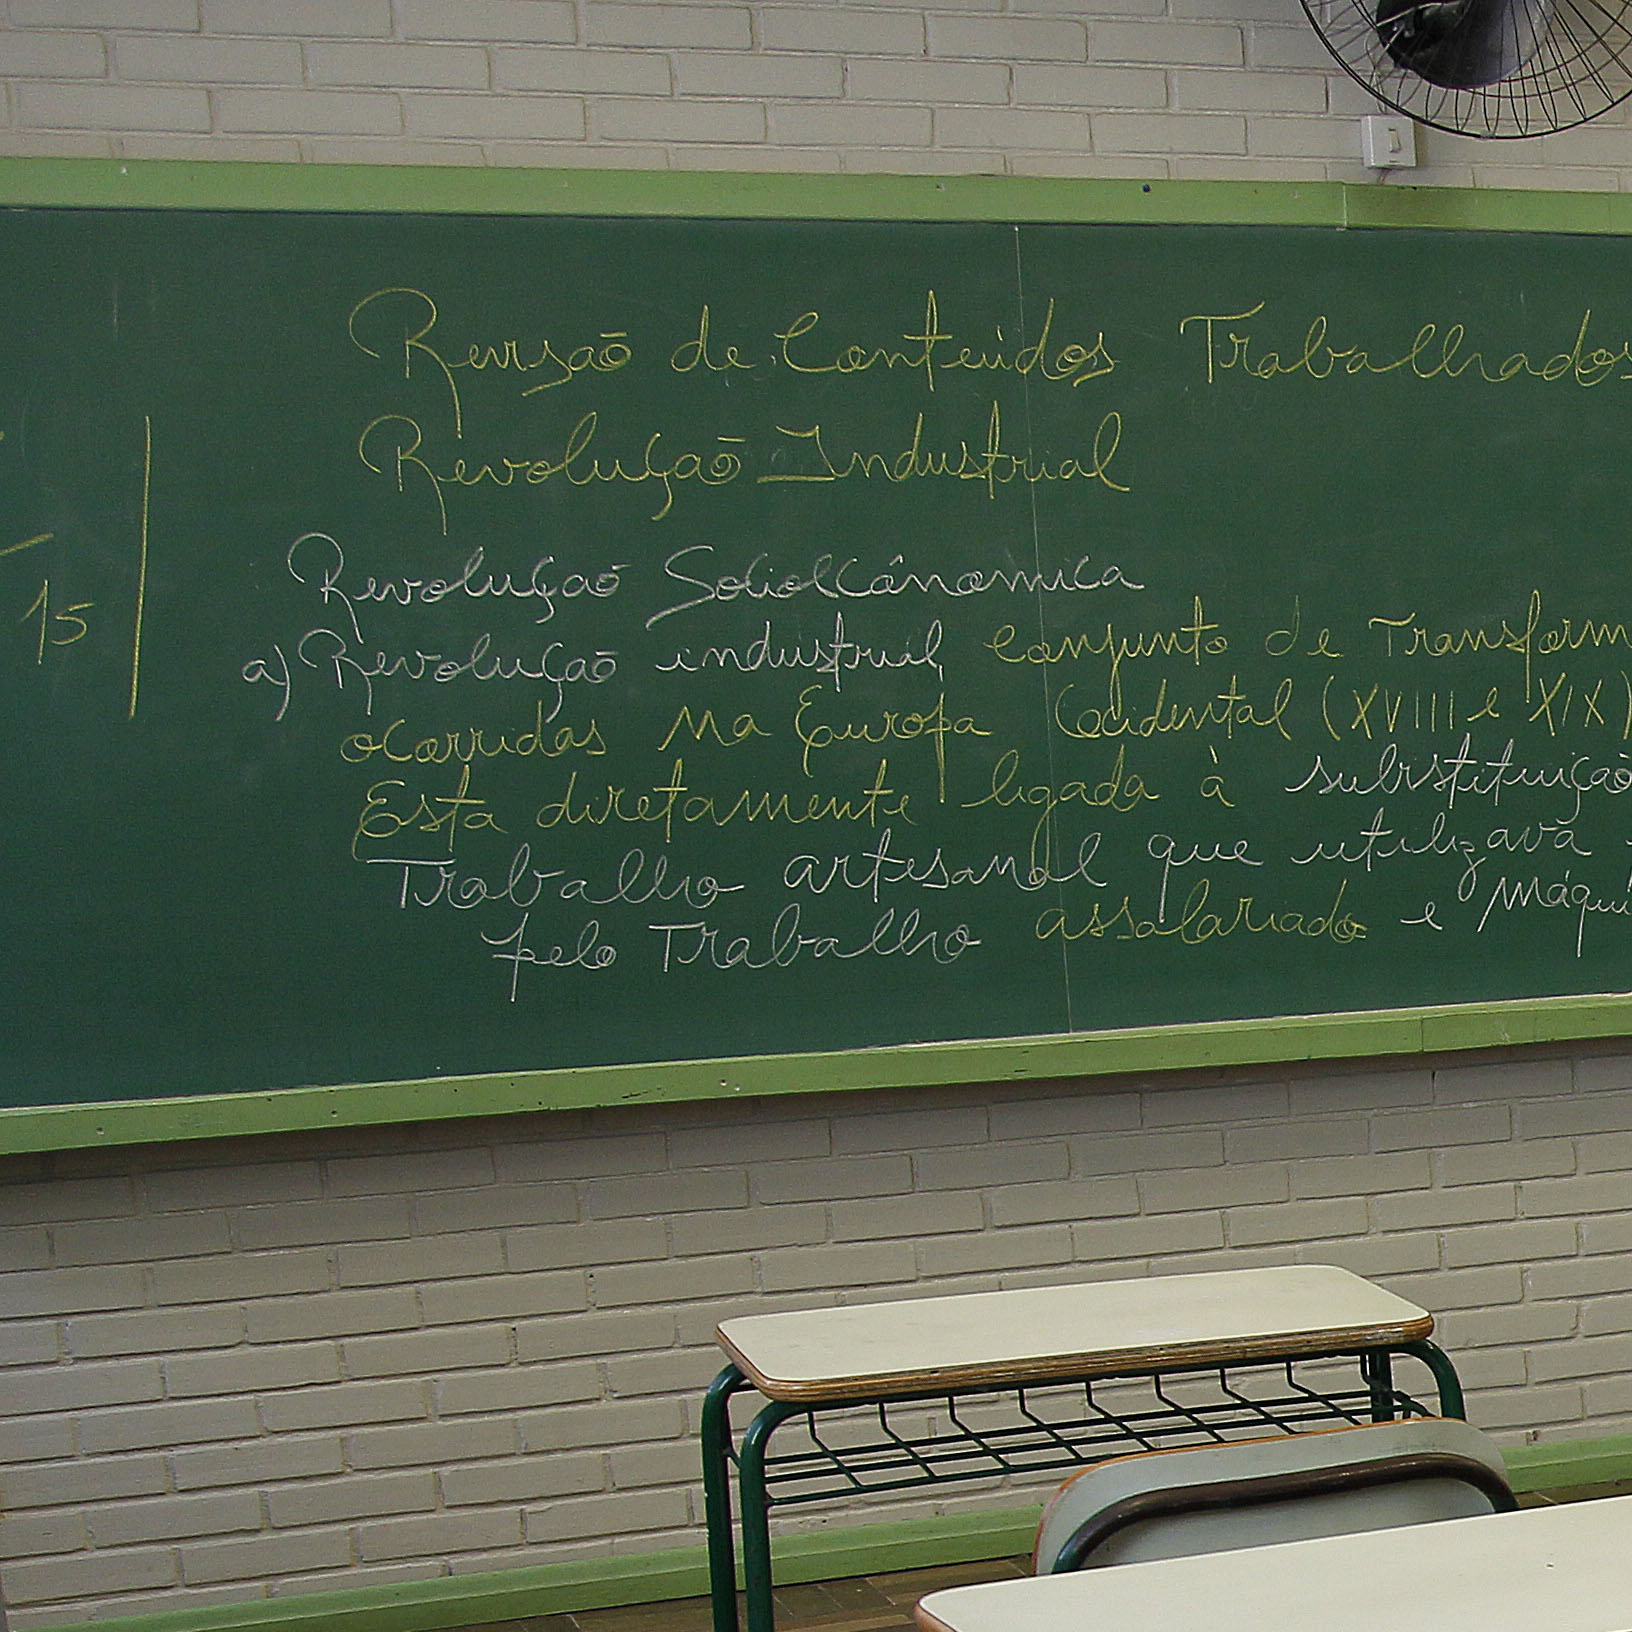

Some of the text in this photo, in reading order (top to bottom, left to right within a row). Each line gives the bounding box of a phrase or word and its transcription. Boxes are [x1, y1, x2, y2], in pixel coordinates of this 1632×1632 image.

[671, 304, 757, 372] de
[757, 400, 1131, 499] Industrial
[1264, 594, 1345, 658] de
[794, 684, 993, 803] Europa
[1467, 686, 1501, 723] e
[536, 757, 919, 843] diretamente
[961, 743, 1160, 884] ligada
[366, 842, 744, 909] Trabalho
[783, 828, 1107, 903] artesanal
[1148, 833, 1264, 923] que
[480, 912, 617, 1002] pelo
[649, 902, 982, 972] Trabalho
[1035, 878, 1367, 944] assalariado
[1400, 900, 1443, 931] e
